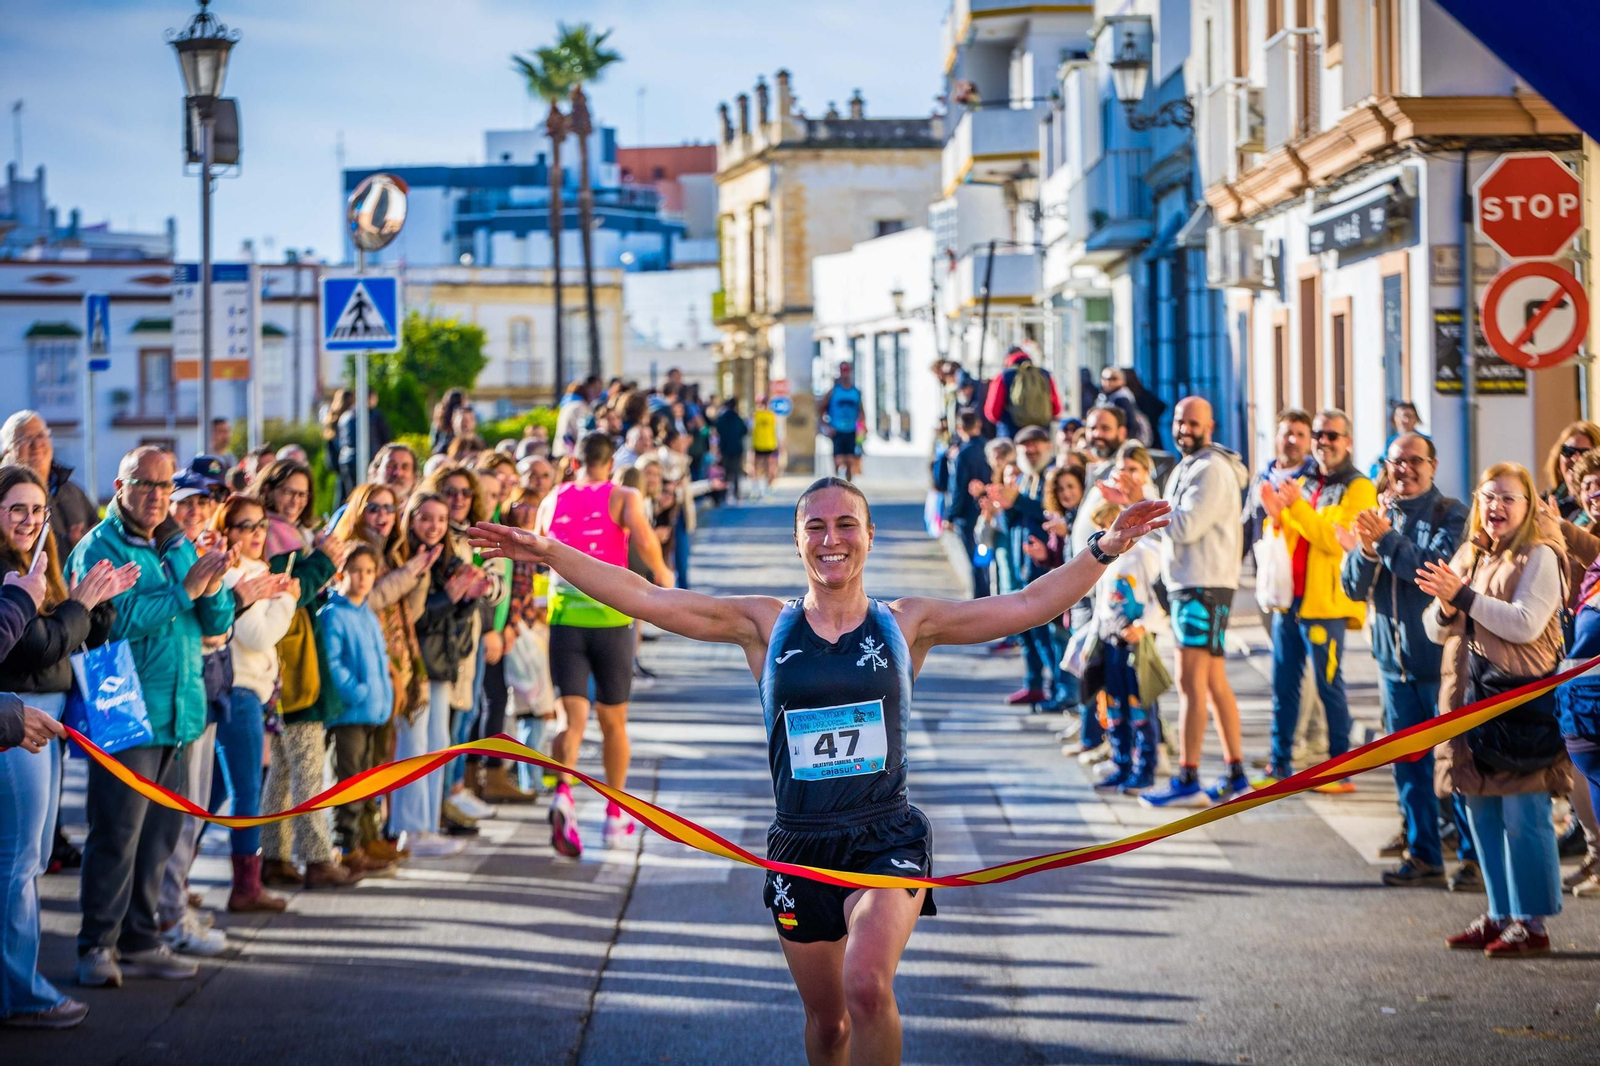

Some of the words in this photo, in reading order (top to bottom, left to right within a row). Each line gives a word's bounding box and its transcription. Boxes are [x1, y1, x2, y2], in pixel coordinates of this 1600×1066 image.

[1482, 193, 1579, 222] STOP
[814, 729, 860, 758] 47
[821, 766, 853, 776] cajasur
